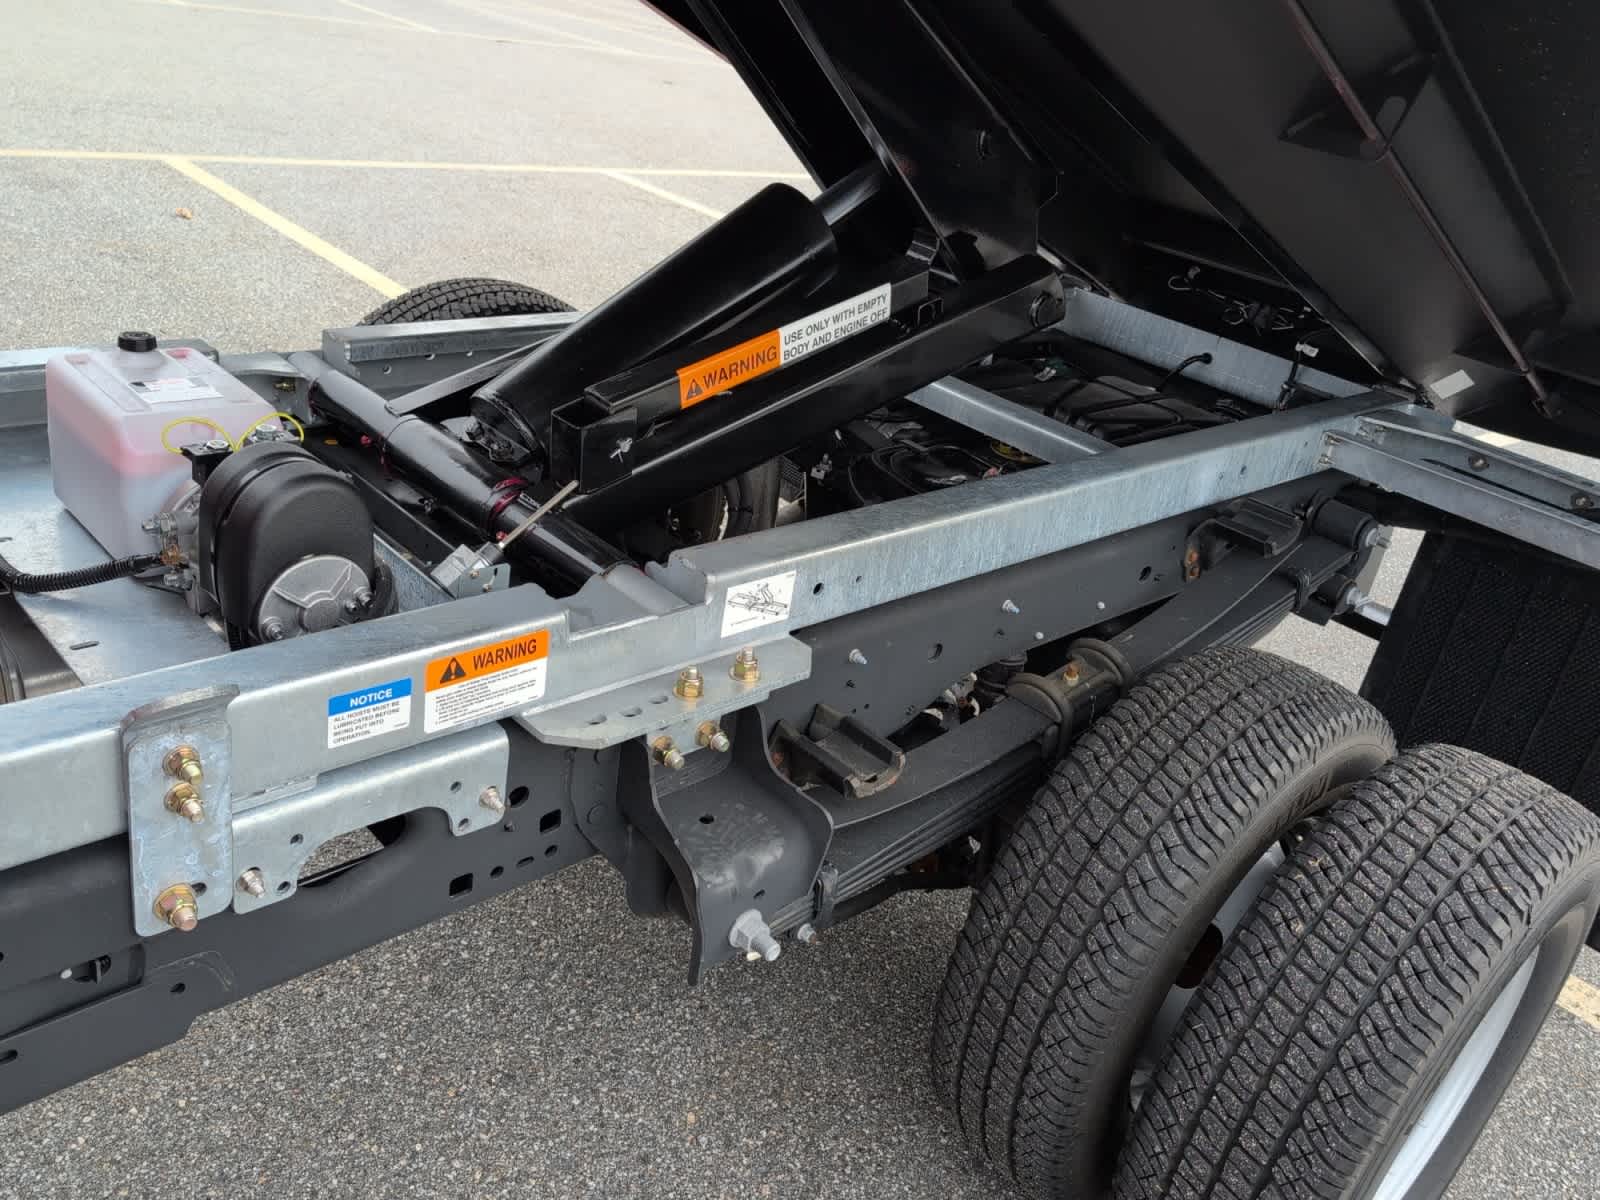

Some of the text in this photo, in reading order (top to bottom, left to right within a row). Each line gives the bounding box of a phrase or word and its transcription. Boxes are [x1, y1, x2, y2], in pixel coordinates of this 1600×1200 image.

[784, 293, 888, 345] USE ONLY WITH EMPTY
[783, 307, 888, 361] BODY AND ENGINE OFF
[703, 345, 777, 390] WARNING
[473, 638, 537, 671] WARNING
[350, 688, 392, 707] NOTICE
[372, 703, 390, 712] MUST
[333, 708, 400, 730] LUBRICATED BEFORE
[355, 722, 368, 730] PUT
[369, 719, 384, 727] INTO
